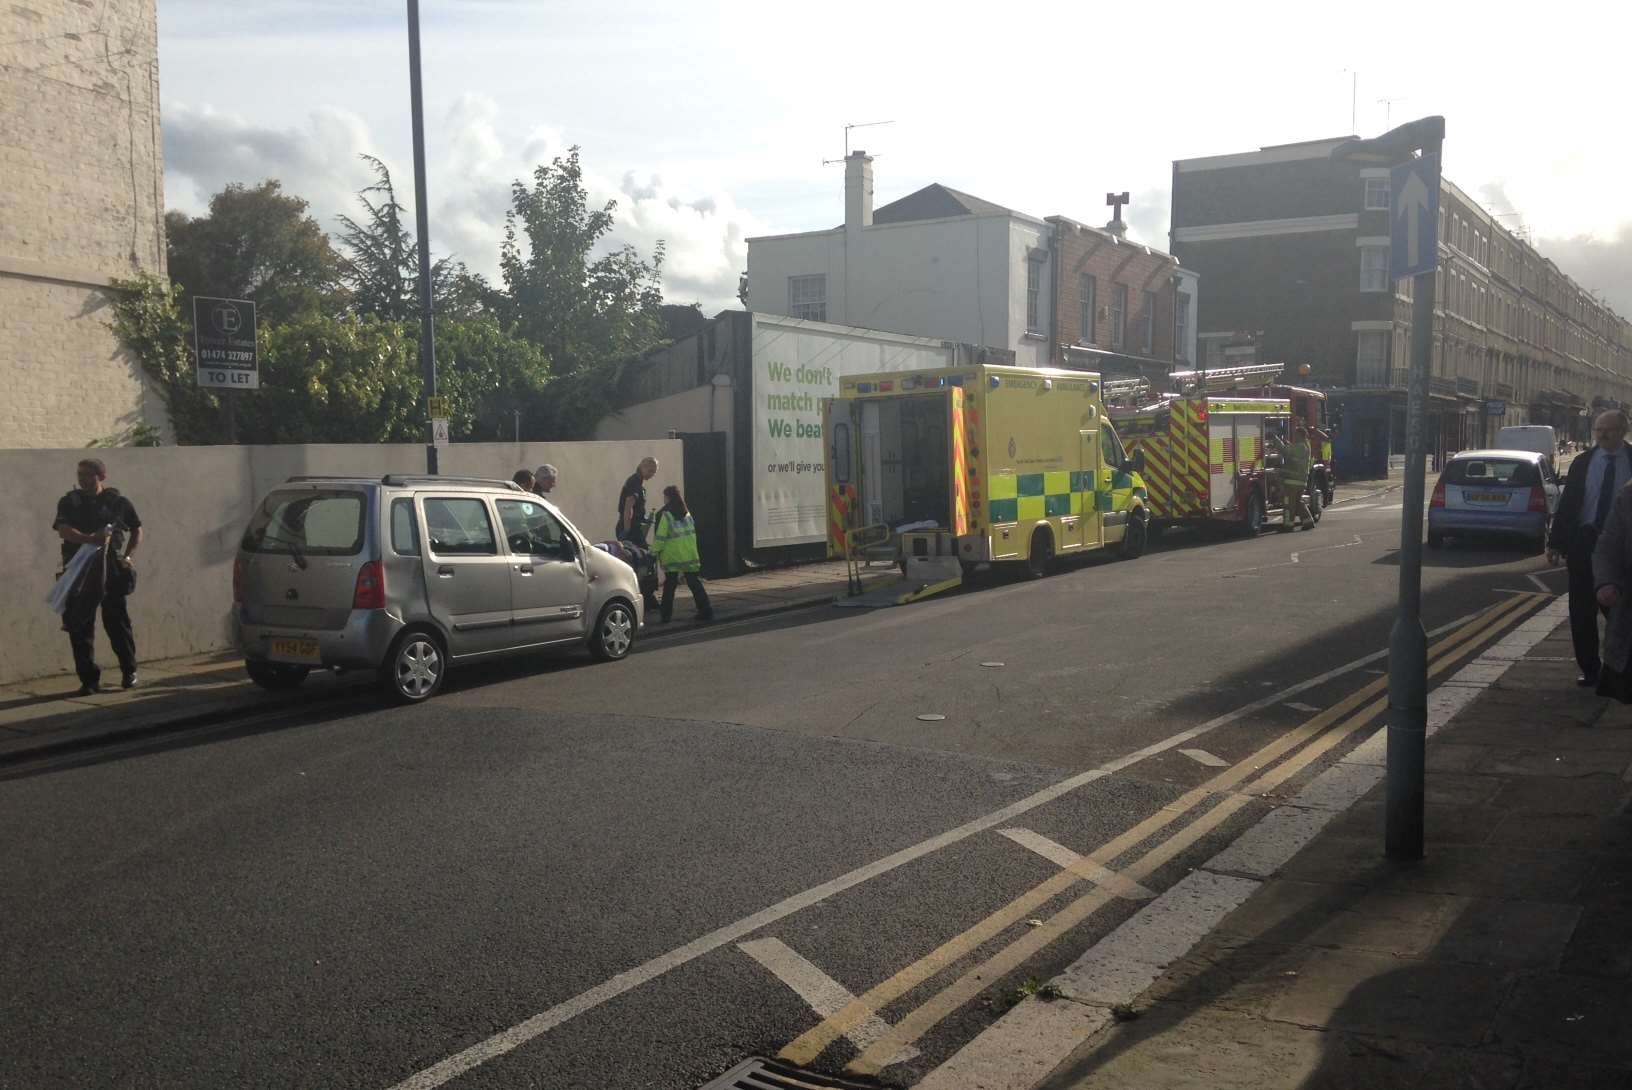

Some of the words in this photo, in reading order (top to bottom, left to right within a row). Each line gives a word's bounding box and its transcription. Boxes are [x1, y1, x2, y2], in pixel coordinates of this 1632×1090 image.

[208, 371, 226, 383] TO
[231, 373, 250, 385] LET
[767, 362, 792, 383] We
[796, 364, 832, 386] don't
[767, 392, 812, 412] match
[767, 419, 792, 438] We
[768, 463, 776, 473] or
[796, 460, 811, 475] give
